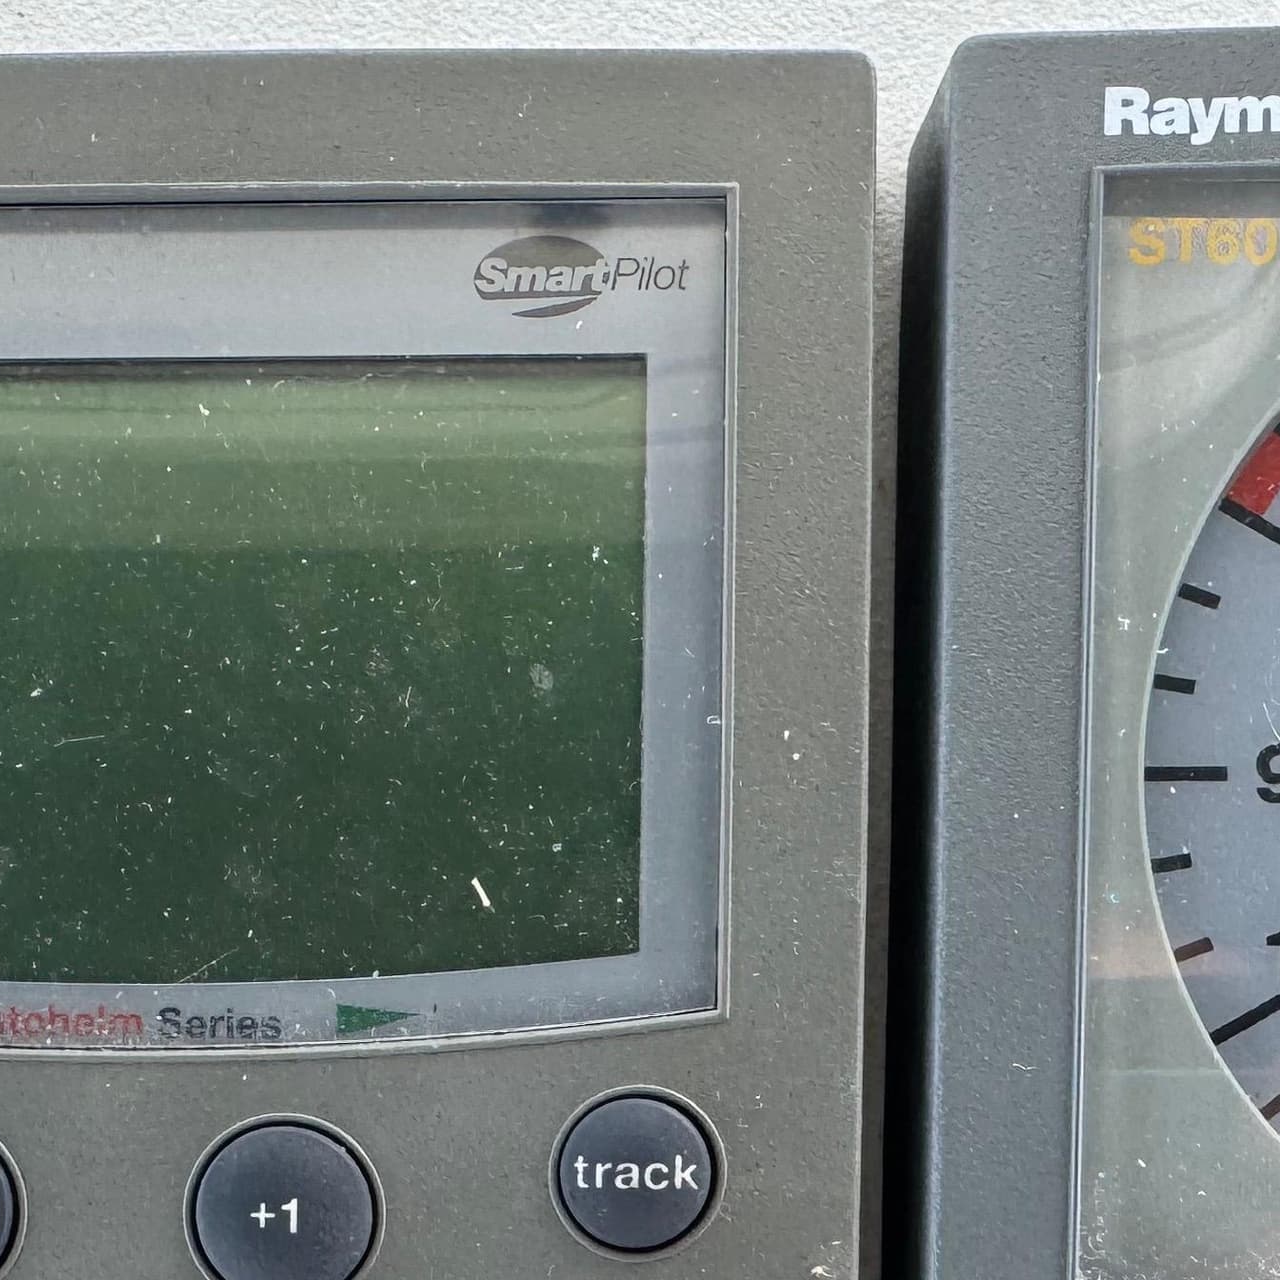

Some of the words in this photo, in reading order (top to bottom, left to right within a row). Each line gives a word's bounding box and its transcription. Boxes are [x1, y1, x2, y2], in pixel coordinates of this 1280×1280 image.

[1128, 217, 1279, 266] ST60
[157, 1006, 283, 1039] Series
[574, 1154, 699, 1190] track
[250, 1198, 299, 1234] +1
